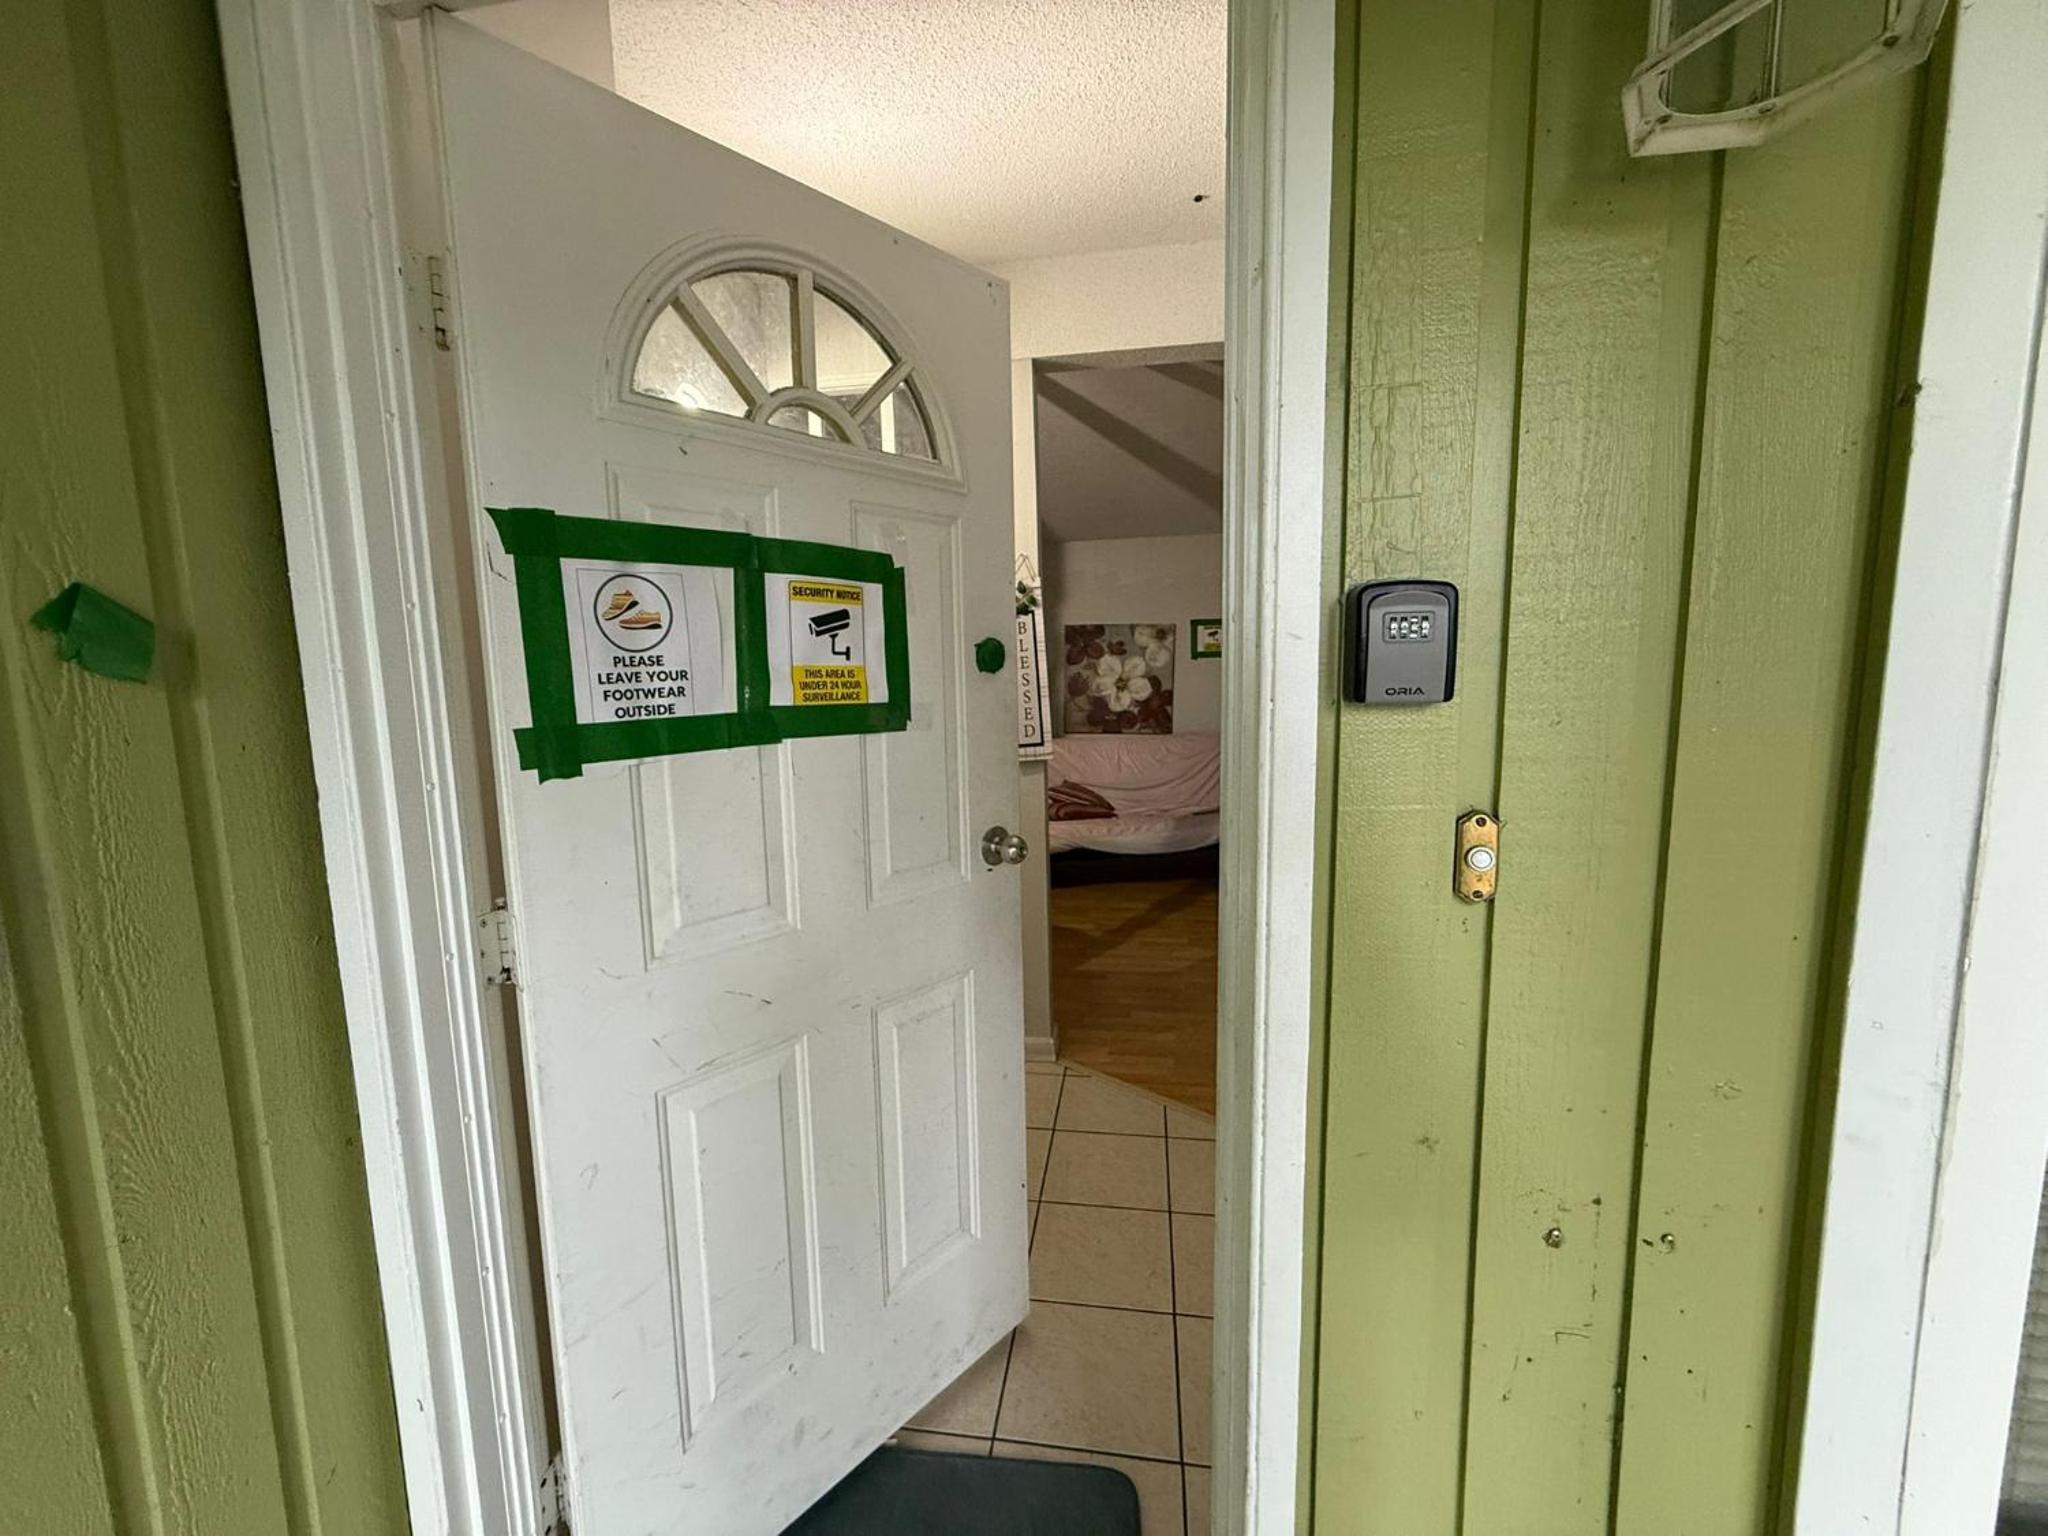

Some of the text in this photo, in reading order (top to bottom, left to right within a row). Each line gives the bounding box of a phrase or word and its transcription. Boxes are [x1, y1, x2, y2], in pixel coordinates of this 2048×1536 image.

[792, 587, 861, 601] SECURITY NOTICE
[613, 655, 665, 668] PLEASE
[598, 670, 689, 685] LEAVE YOUR
[804, 669, 855, 678] THIS AREA IS
[1018, 621, 1036, 738] BLESSED
[799, 680, 862, 690] UNDER 24 HOUR
[1385, 687, 1425, 696] ORIA
[603, 686, 686, 701] FOOTWEAR
[802, 691, 861, 702] SURVEILLANCE
[615, 704, 676, 718] OUTSIDE
